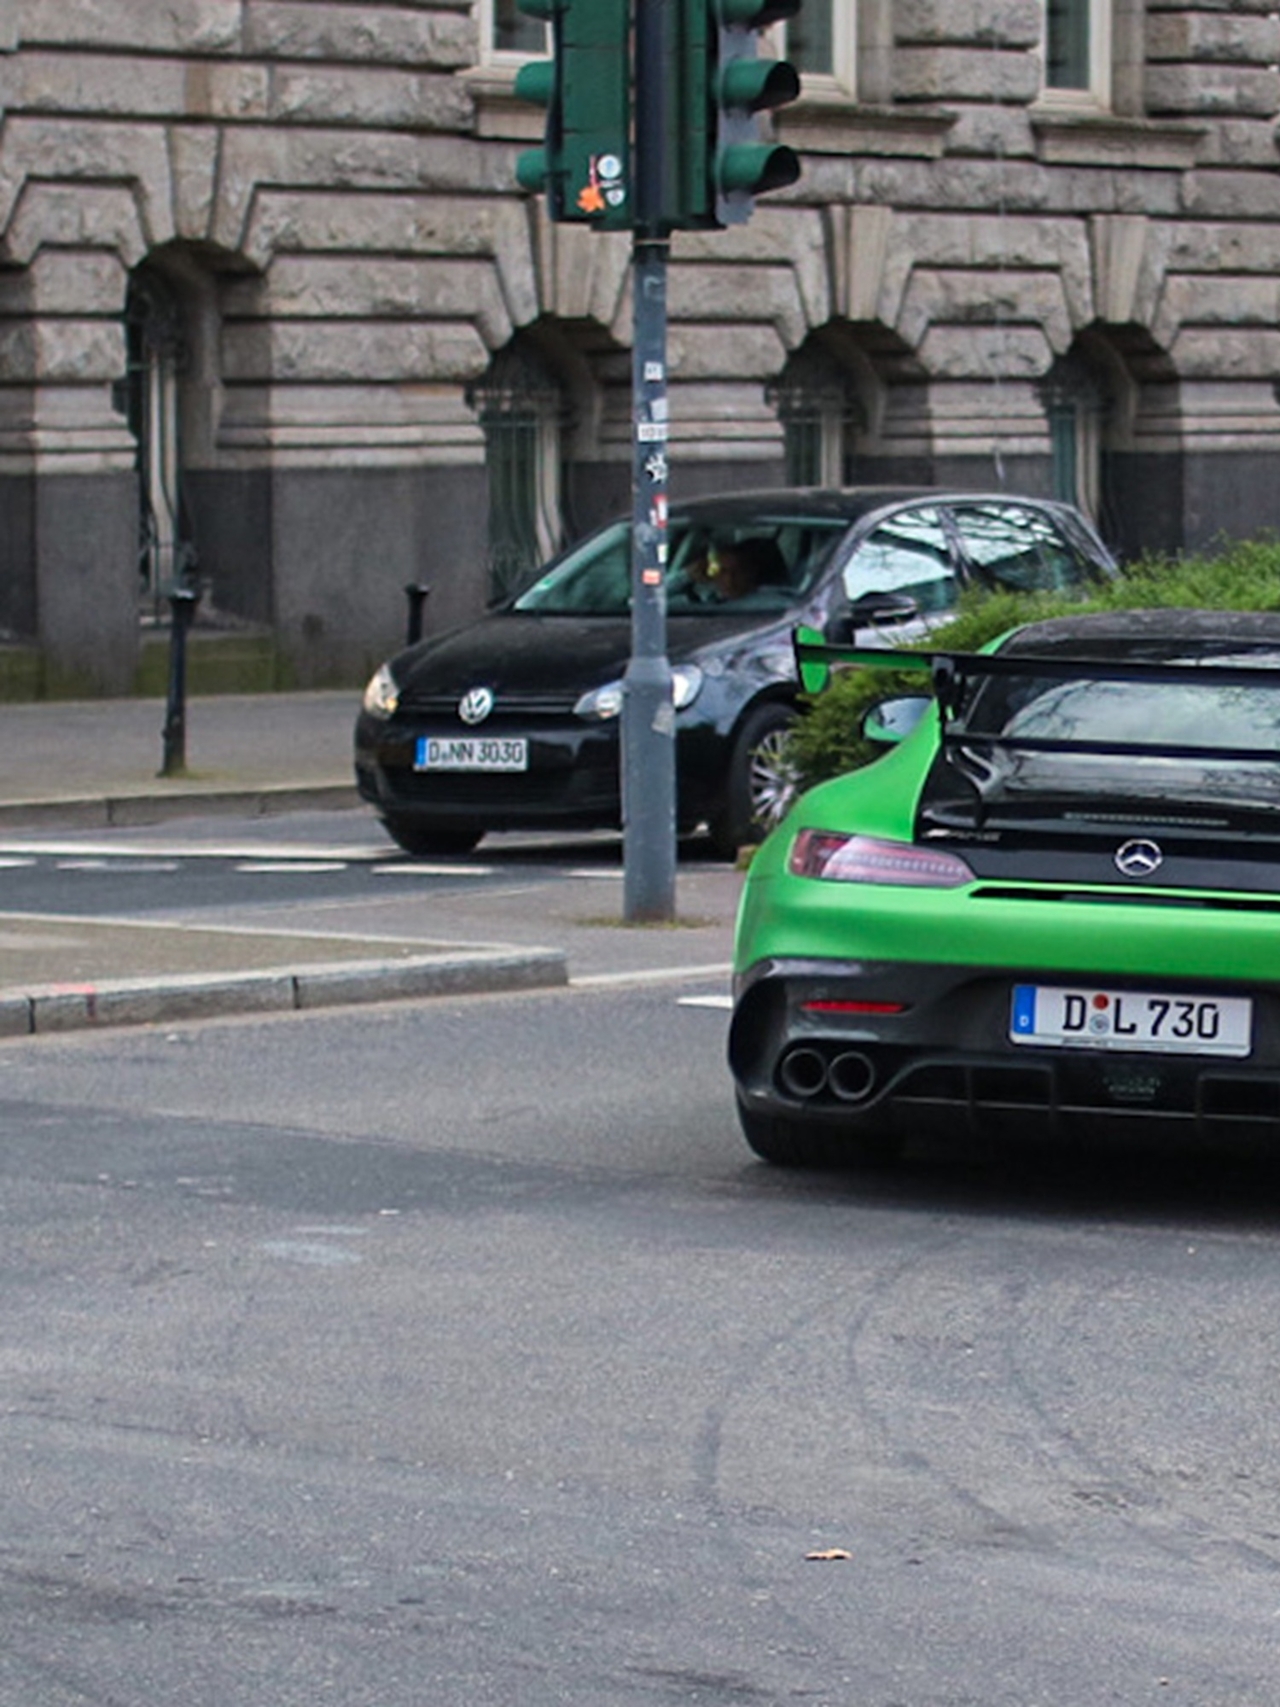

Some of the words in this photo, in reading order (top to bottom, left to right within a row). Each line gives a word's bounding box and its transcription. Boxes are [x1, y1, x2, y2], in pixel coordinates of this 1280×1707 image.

[478, 741, 523, 763] 3030
[1062, 994, 1087, 1031] D
[1114, 997, 1137, 1034] L
[1147, 1000, 1219, 1039] 730
